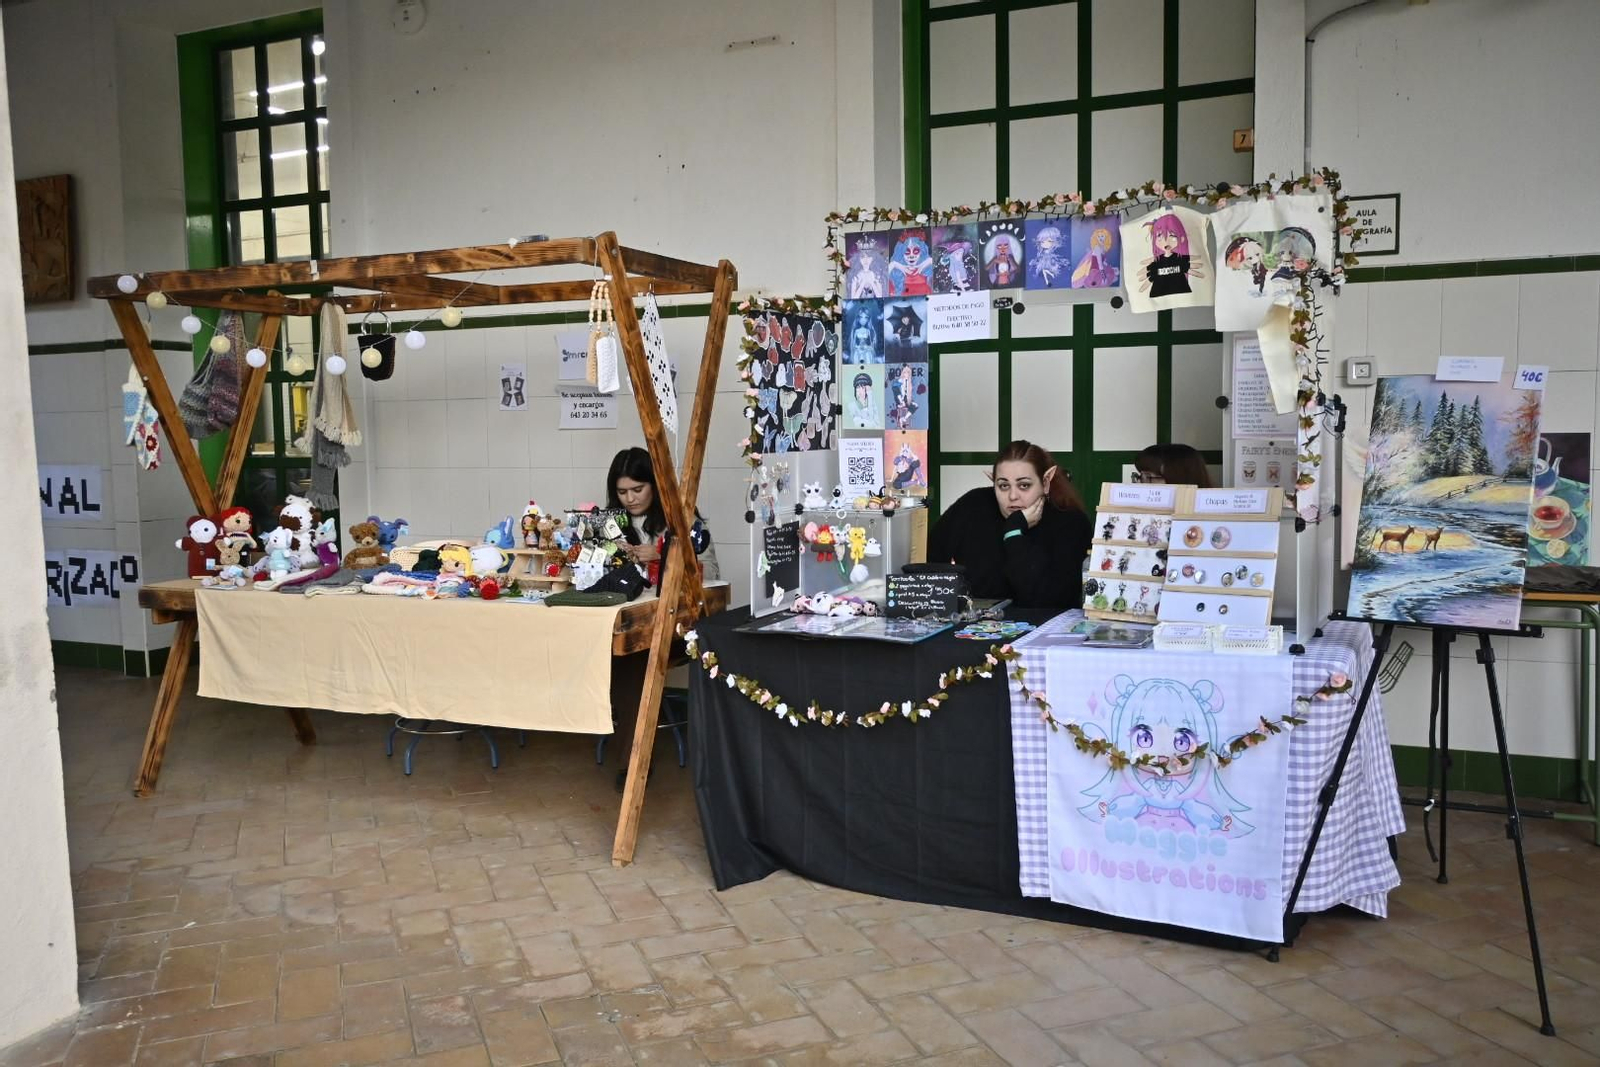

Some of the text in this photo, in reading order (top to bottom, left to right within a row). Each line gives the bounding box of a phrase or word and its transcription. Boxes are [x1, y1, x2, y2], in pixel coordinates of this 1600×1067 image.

[1356, 209, 1377, 217] AULA
[888, 367, 924, 378] POER
[578, 401, 605, 410] encargos
[570, 411, 581, 419] 643
[582, 411, 590, 419] 20
[1105, 815, 1227, 863] Maggie
